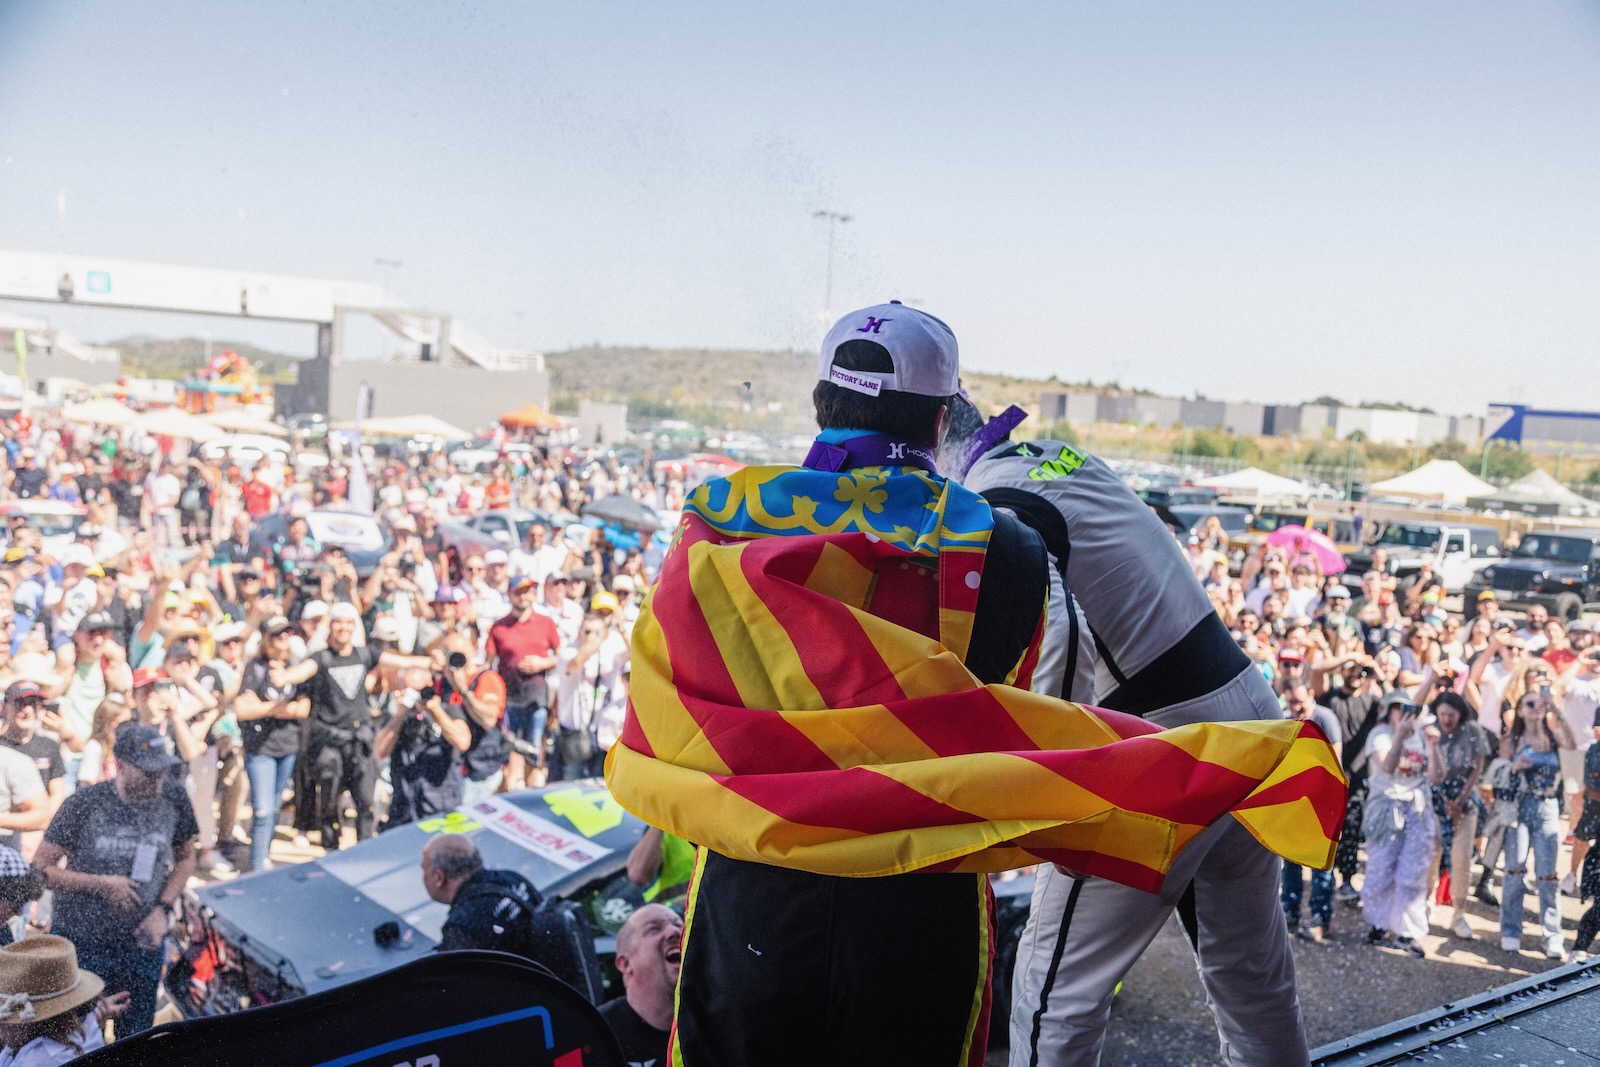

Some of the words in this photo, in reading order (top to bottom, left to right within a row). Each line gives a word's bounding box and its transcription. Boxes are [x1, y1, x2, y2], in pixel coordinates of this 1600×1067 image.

[831, 369, 859, 385] VICTORY
[859, 379, 879, 391] LANE
[886, 442, 907, 460] H
